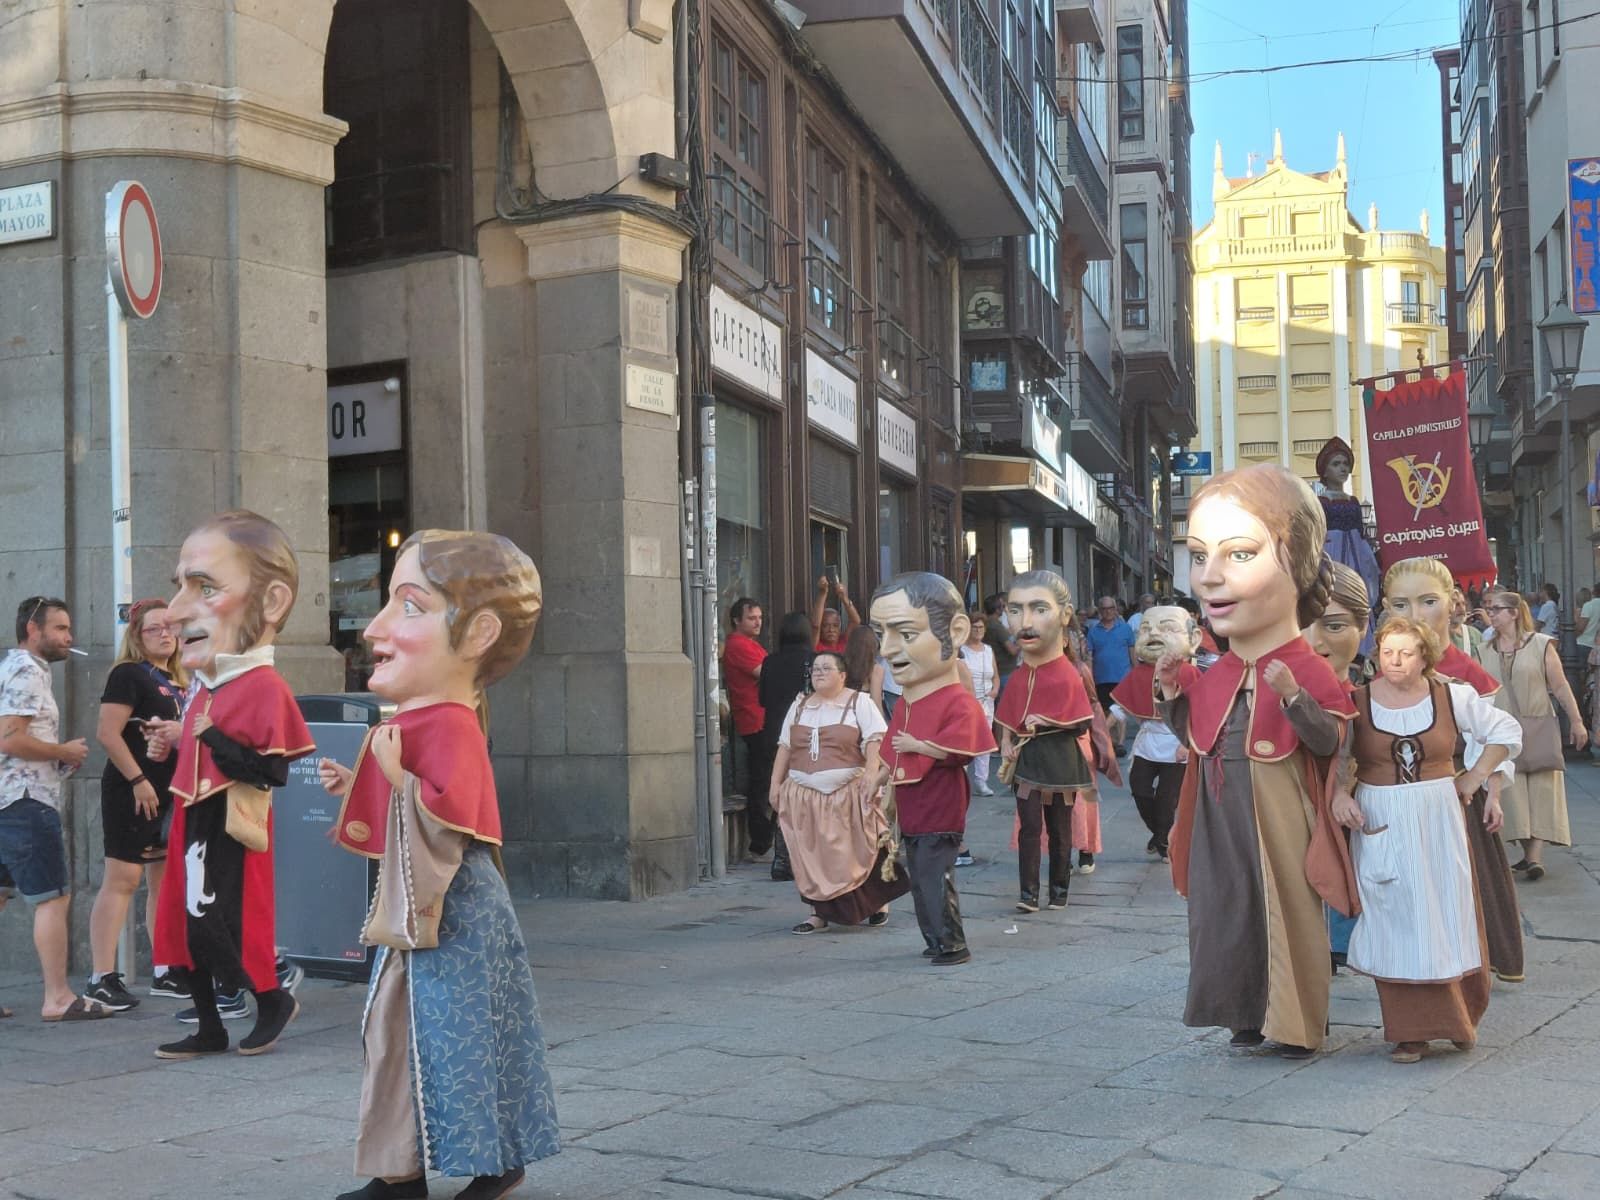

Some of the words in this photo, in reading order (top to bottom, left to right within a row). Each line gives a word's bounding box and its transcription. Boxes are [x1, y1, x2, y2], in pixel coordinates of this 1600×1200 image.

[0, 192, 43, 212] PLAZA
[0, 213, 46, 233] MAYOR
[1372, 426, 1406, 442] CAPILLA
